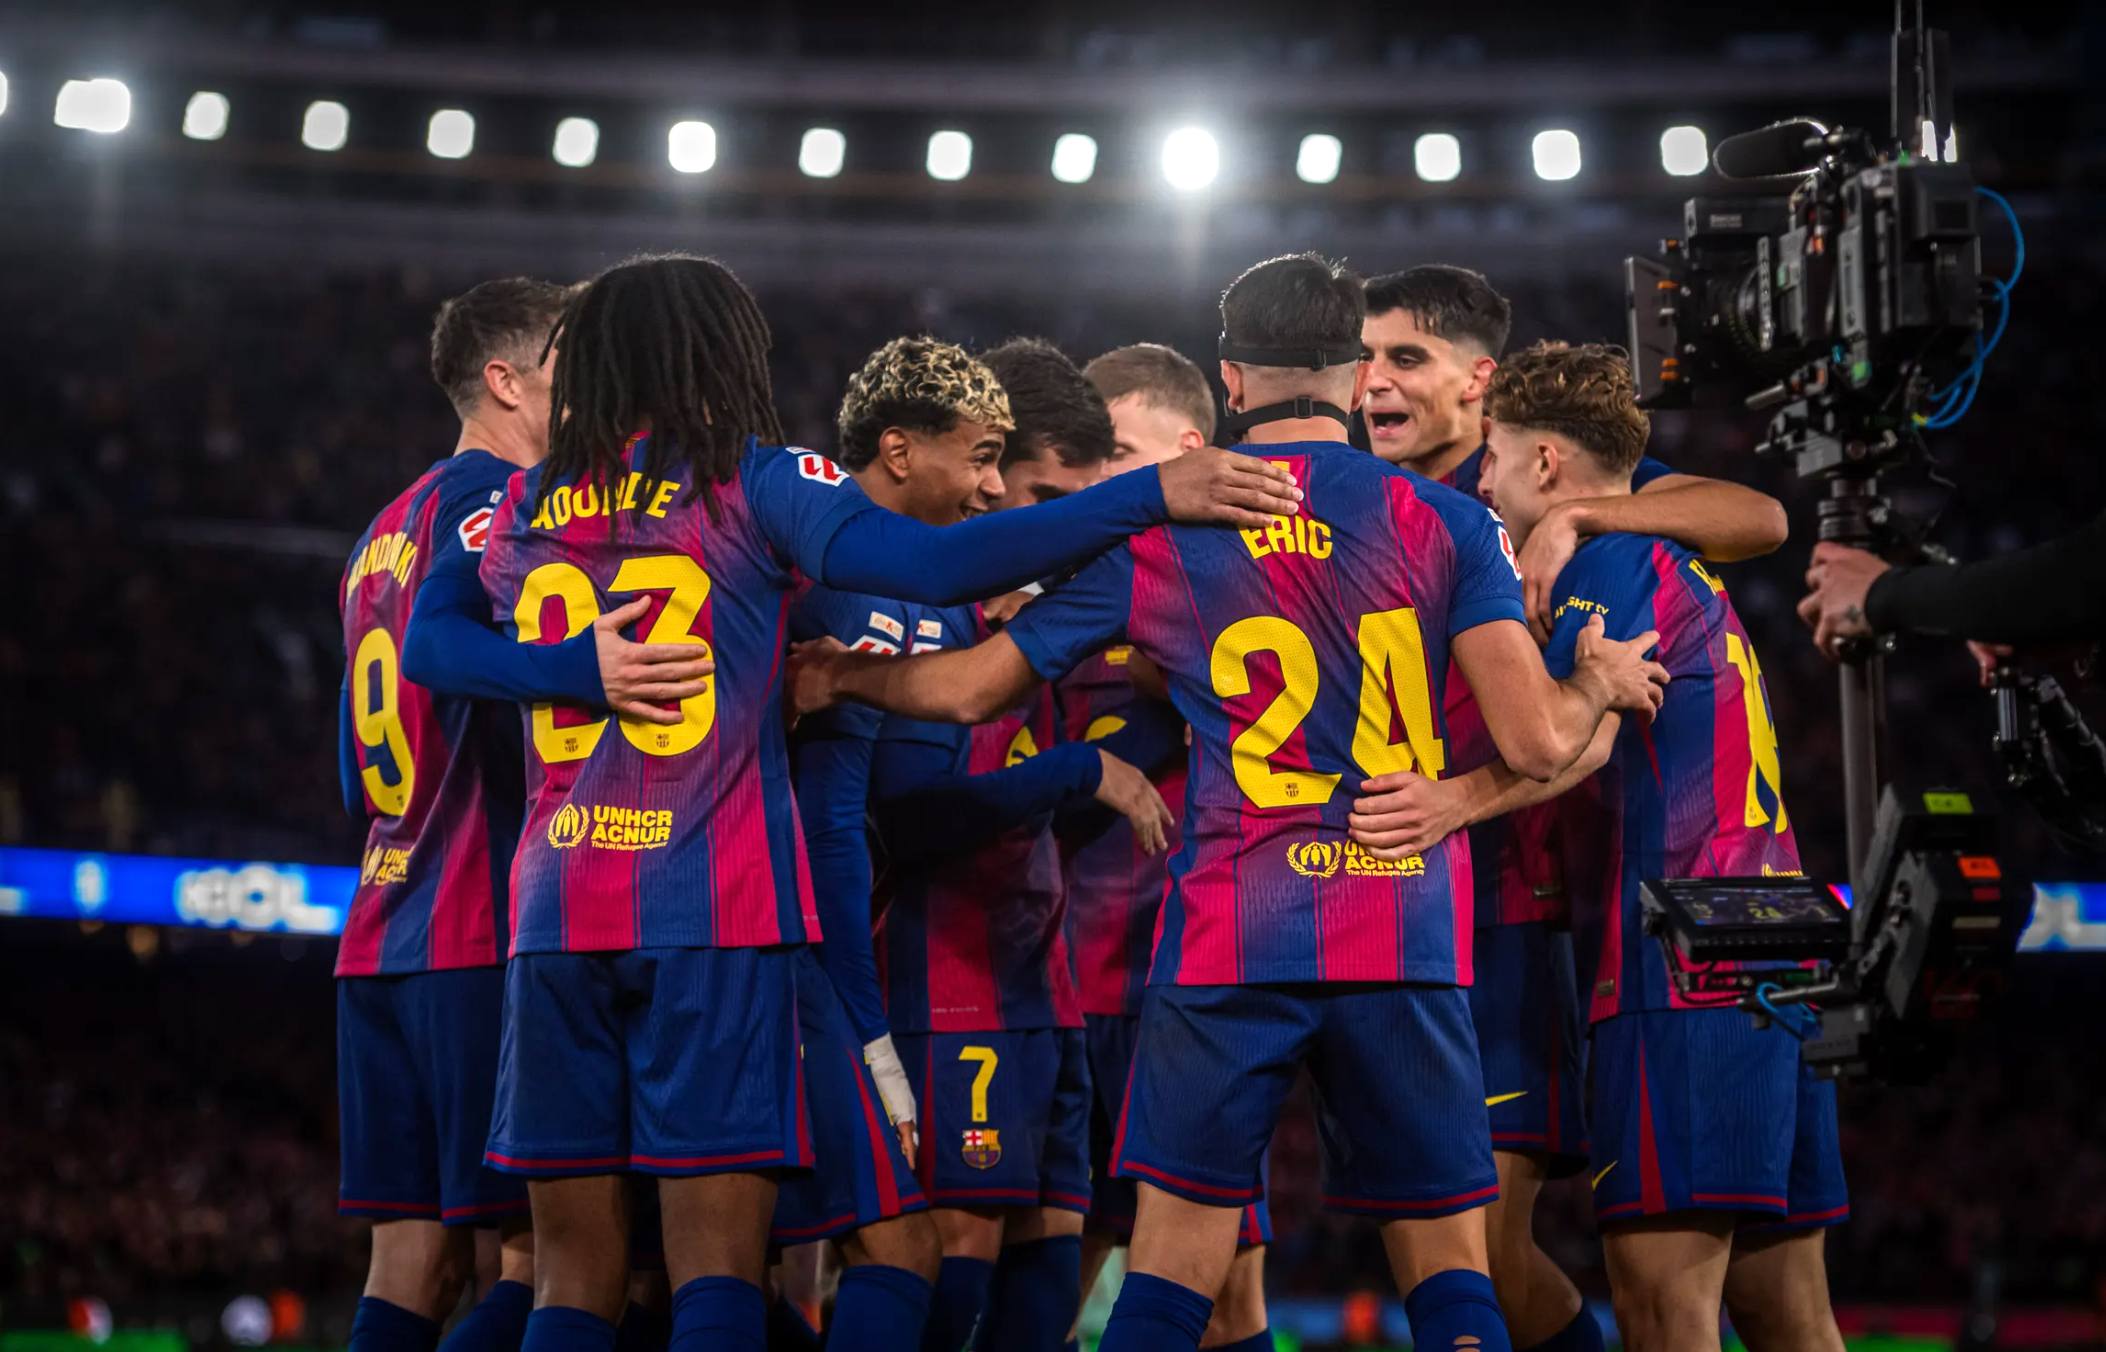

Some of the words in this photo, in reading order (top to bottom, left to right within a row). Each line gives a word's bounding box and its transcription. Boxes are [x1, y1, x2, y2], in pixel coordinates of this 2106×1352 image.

[1239, 513, 1333, 560] ERIC
[353, 627, 416, 817] 9
[1210, 607, 1445, 809] 24
[591, 823, 671, 843] ACNUR
[593, 805, 673, 827] UNHCR
[959, 1045, 998, 1122] 7
